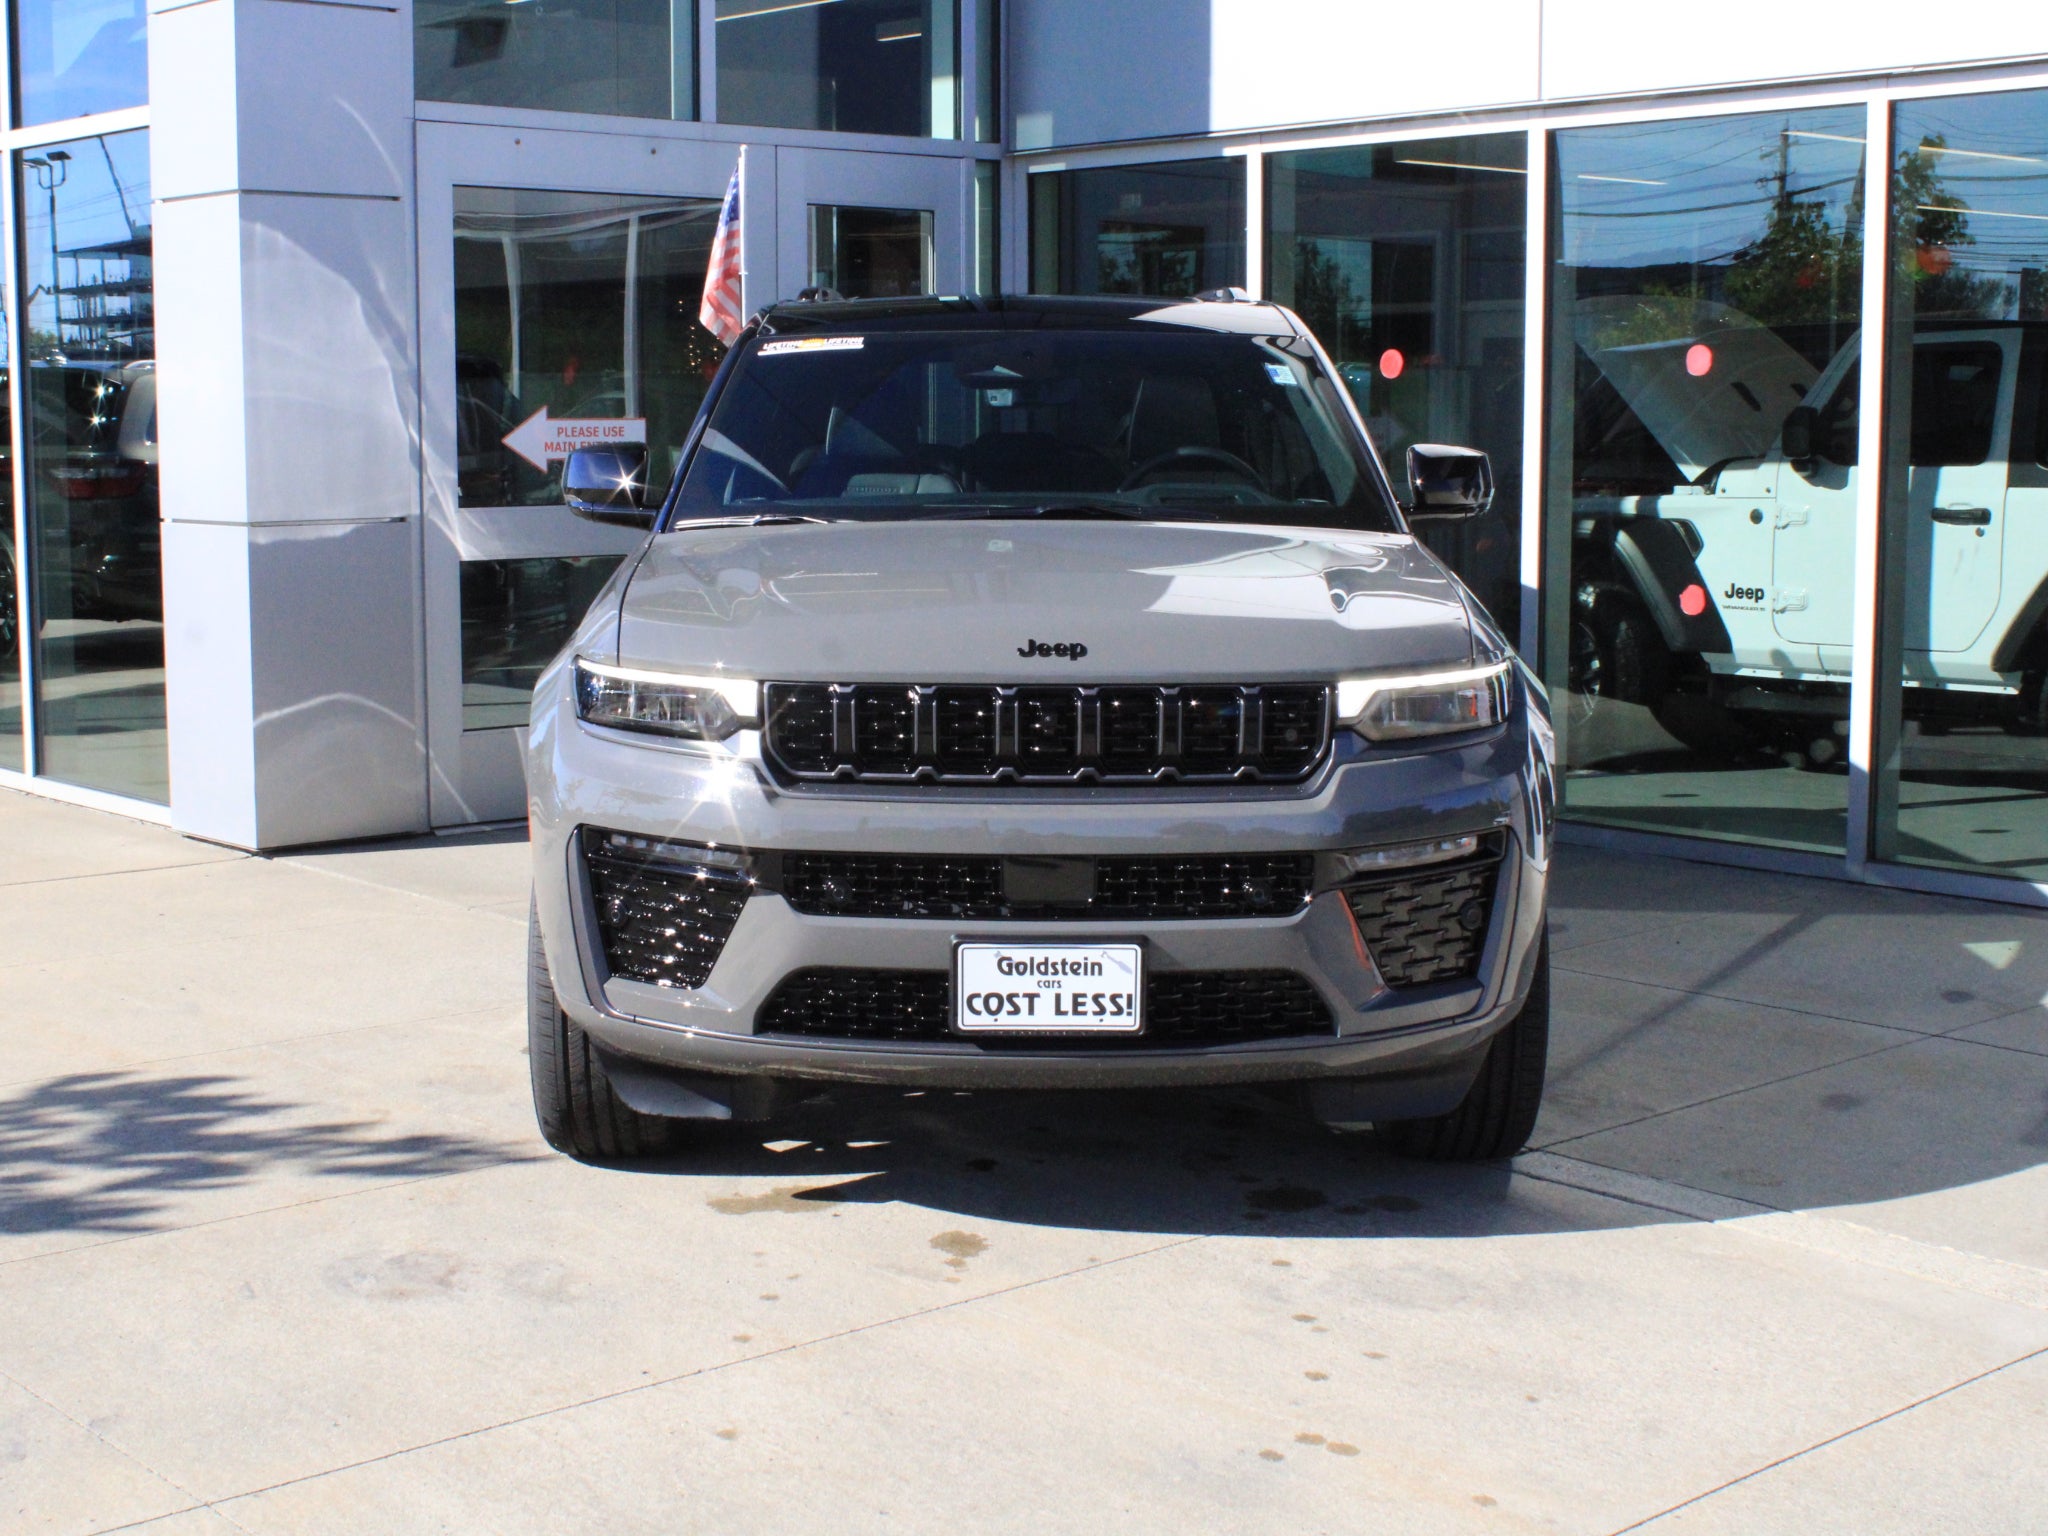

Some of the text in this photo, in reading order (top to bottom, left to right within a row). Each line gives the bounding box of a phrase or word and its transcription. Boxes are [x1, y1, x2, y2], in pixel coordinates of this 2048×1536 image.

[557, 426, 625, 438] PLEASE USE
[544, 441, 576, 453] MAIN
[1724, 582, 1765, 603] Jeep
[1017, 638, 1088, 661] Jeep
[997, 956, 1103, 976] Goldstein
[1037, 980, 1062, 989] cars
[966, 992, 1133, 1017] COST LESS!
